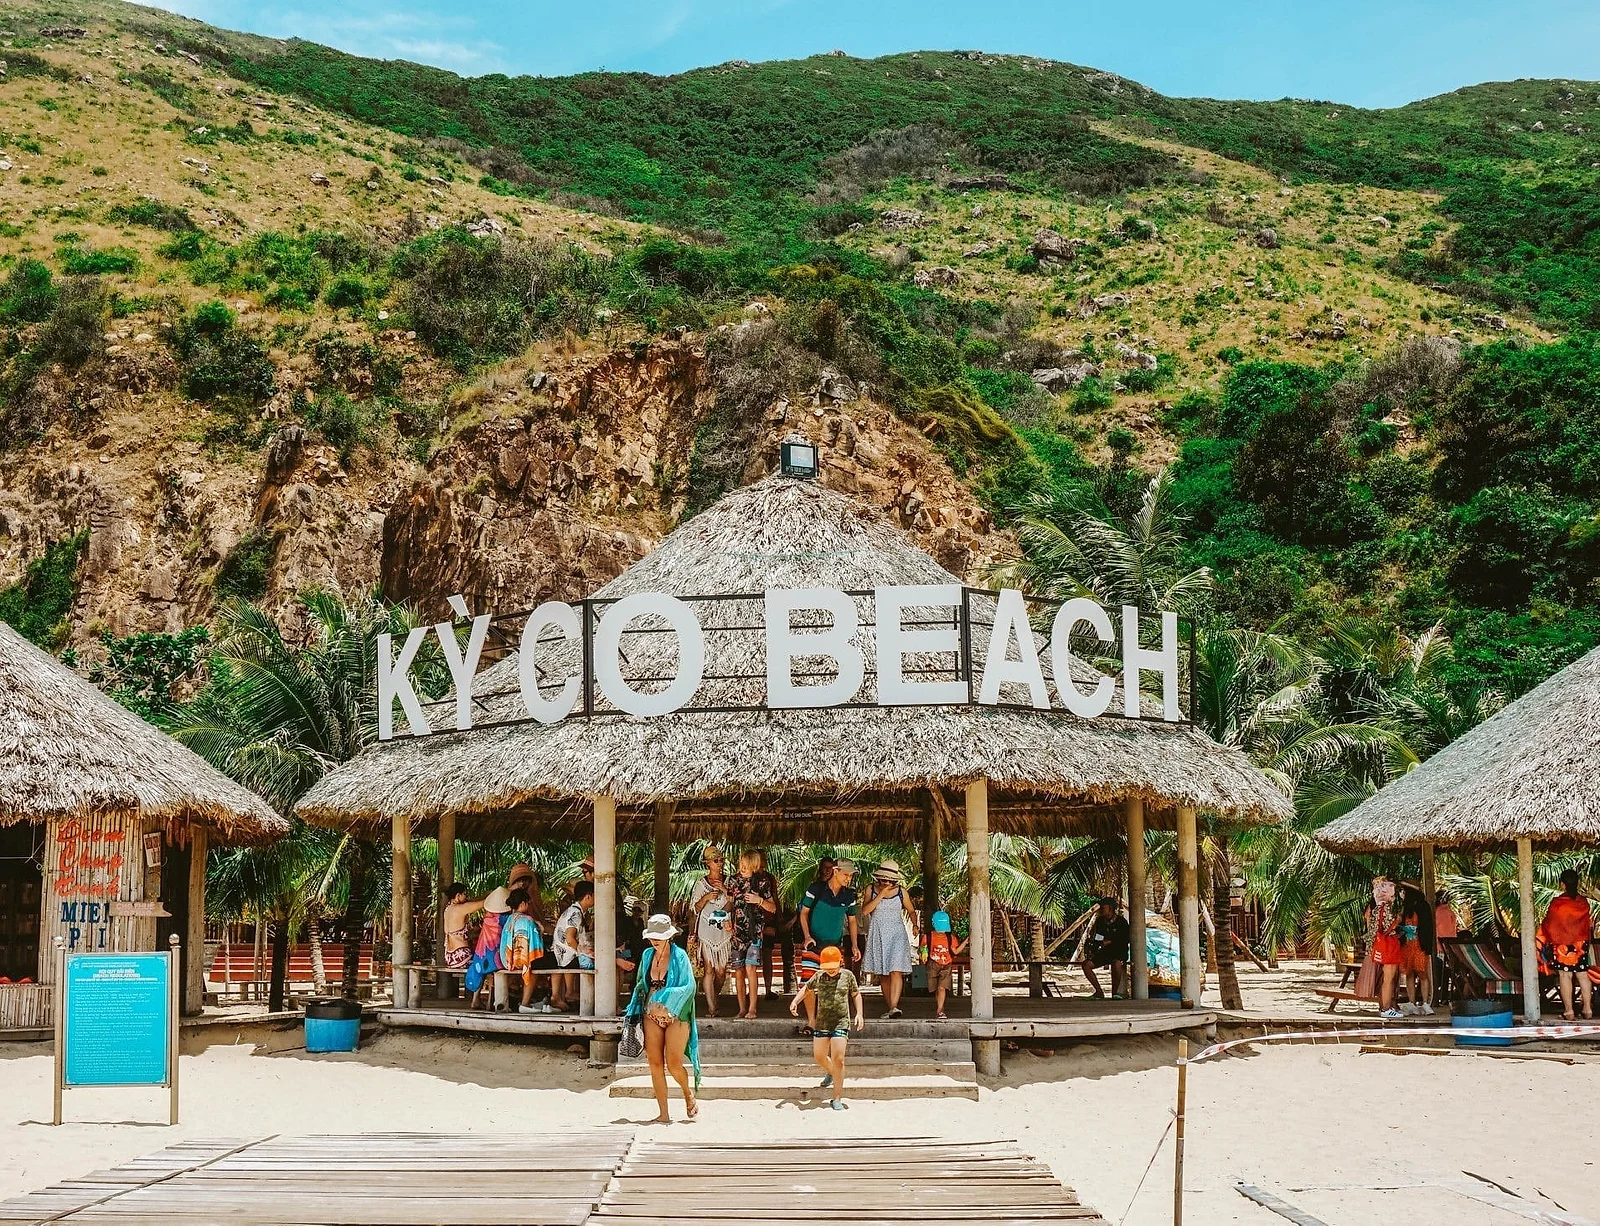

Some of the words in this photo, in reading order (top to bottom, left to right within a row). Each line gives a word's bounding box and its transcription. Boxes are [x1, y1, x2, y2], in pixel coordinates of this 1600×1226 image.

[377, 594, 492, 741] KỲ
[519, 592, 704, 723] CO
[764, 584, 1179, 722] BEACH
